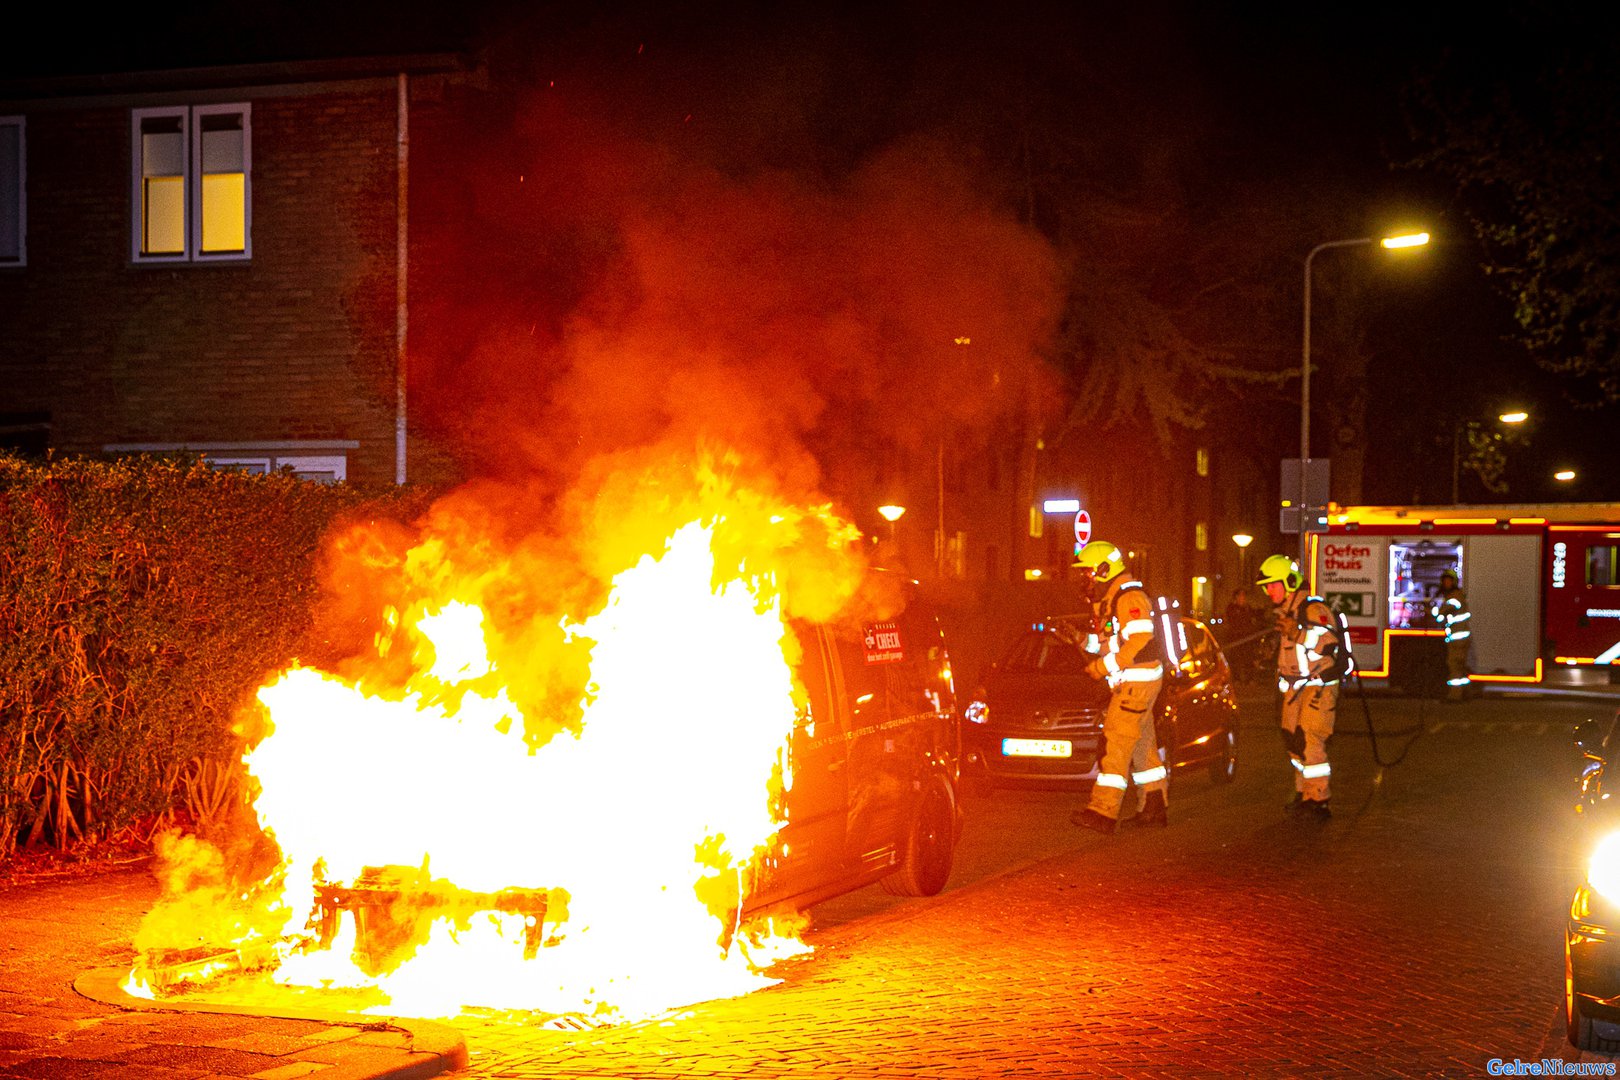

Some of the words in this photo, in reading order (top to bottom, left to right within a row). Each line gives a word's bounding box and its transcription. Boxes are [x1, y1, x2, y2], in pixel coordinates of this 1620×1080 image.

[1324, 544, 1370, 557] Oefen
[1324, 557, 1362, 570] thuis
[875, 632, 901, 650] CHECK
